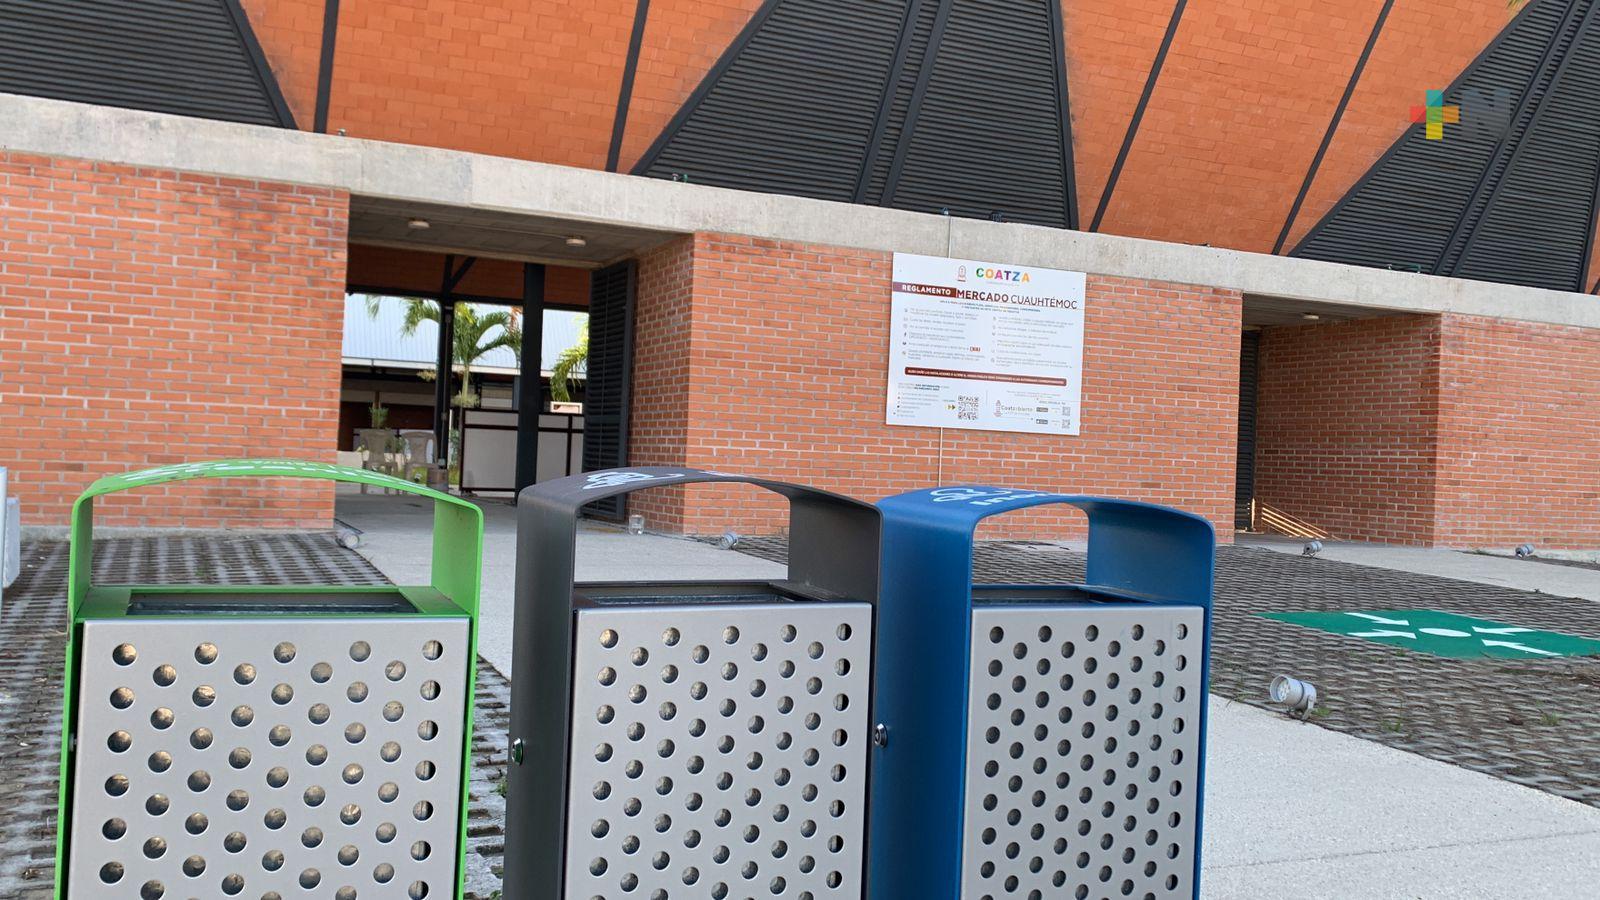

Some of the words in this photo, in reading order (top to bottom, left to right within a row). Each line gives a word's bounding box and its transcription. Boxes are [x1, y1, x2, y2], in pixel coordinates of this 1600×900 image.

[976, 268, 1030, 283] COATZA
[902, 284, 951, 296] REGLAMENTO
[957, 289, 1009, 302] MERCADO
[1011, 295, 1077, 309] CUAUHTÉMOC
